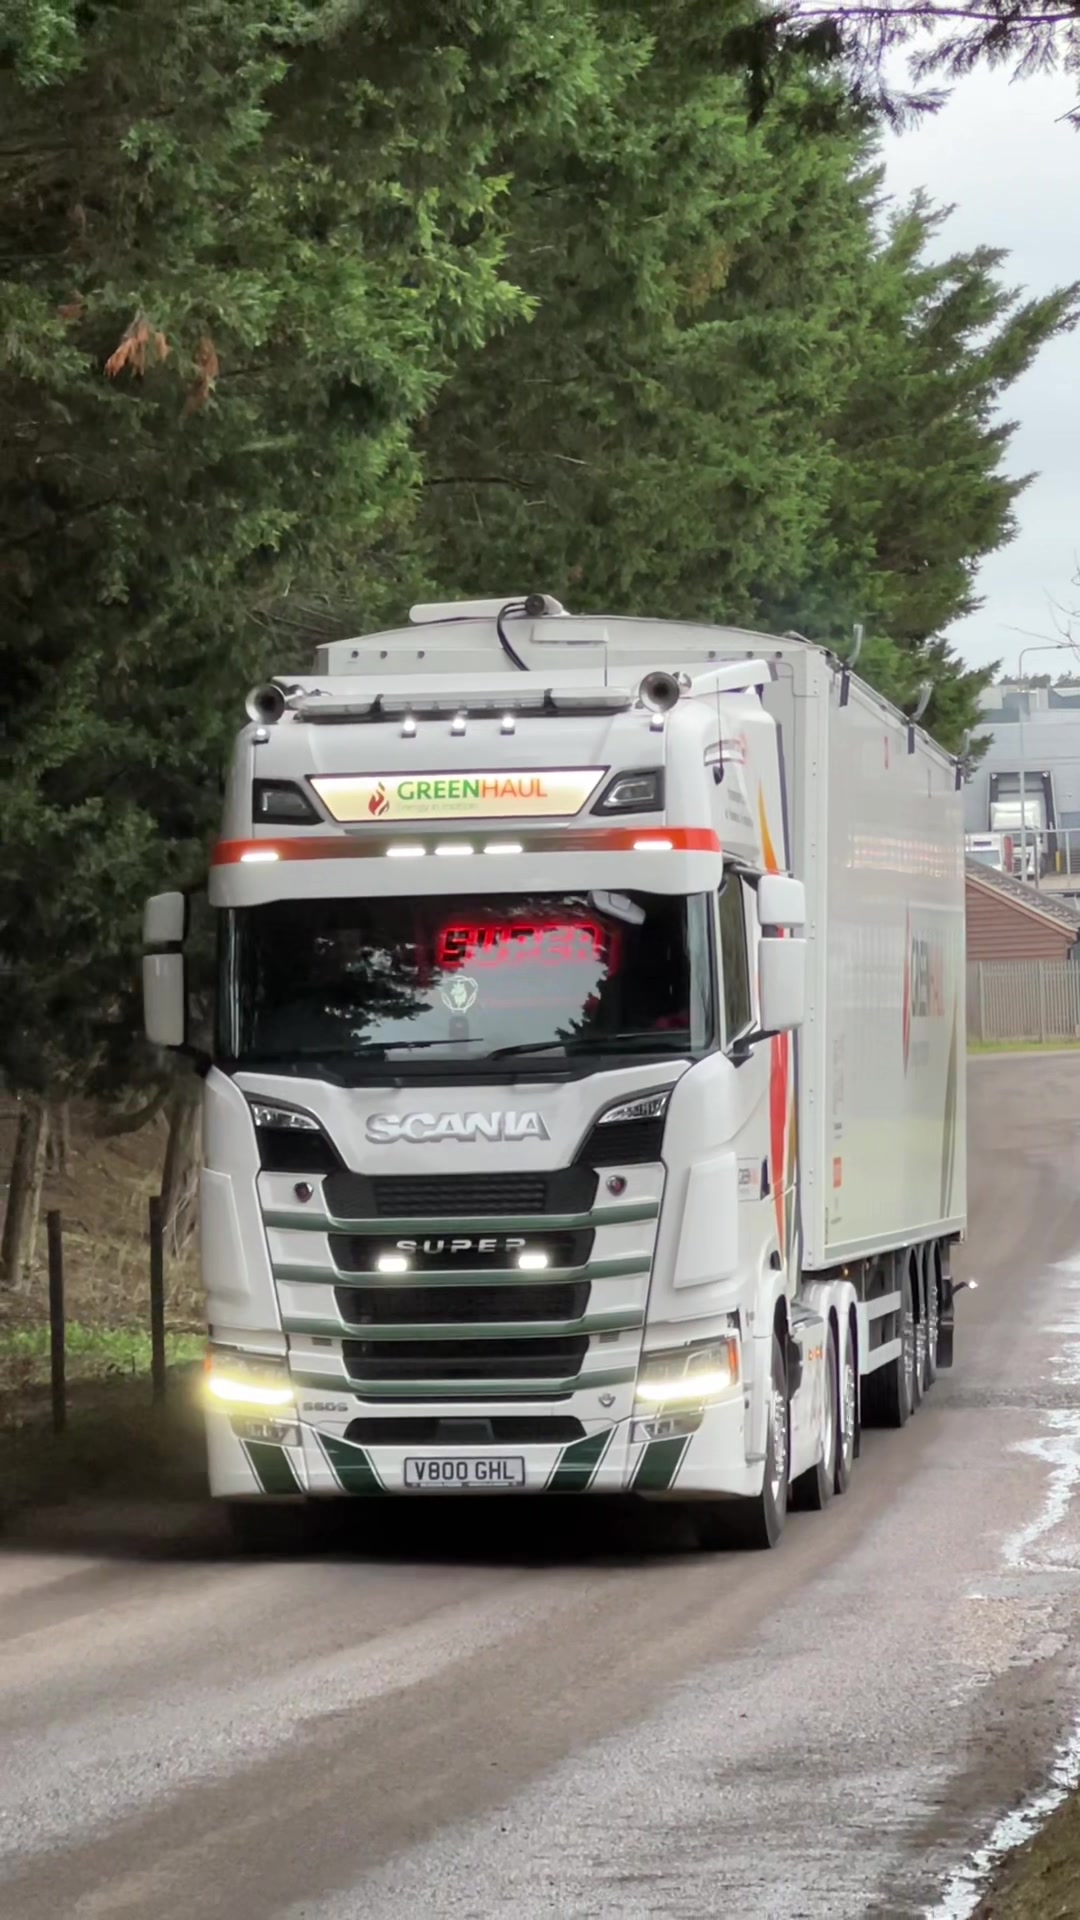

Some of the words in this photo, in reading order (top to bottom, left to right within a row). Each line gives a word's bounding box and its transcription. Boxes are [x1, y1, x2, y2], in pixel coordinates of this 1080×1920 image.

[397, 779, 548, 800] GREENHAUL
[365, 1111, 551, 1144] SCANIA
[396, 1238, 526, 1254] SUPER
[415, 1461, 468, 1480] V800
[475, 1461, 515, 1480] GHL
